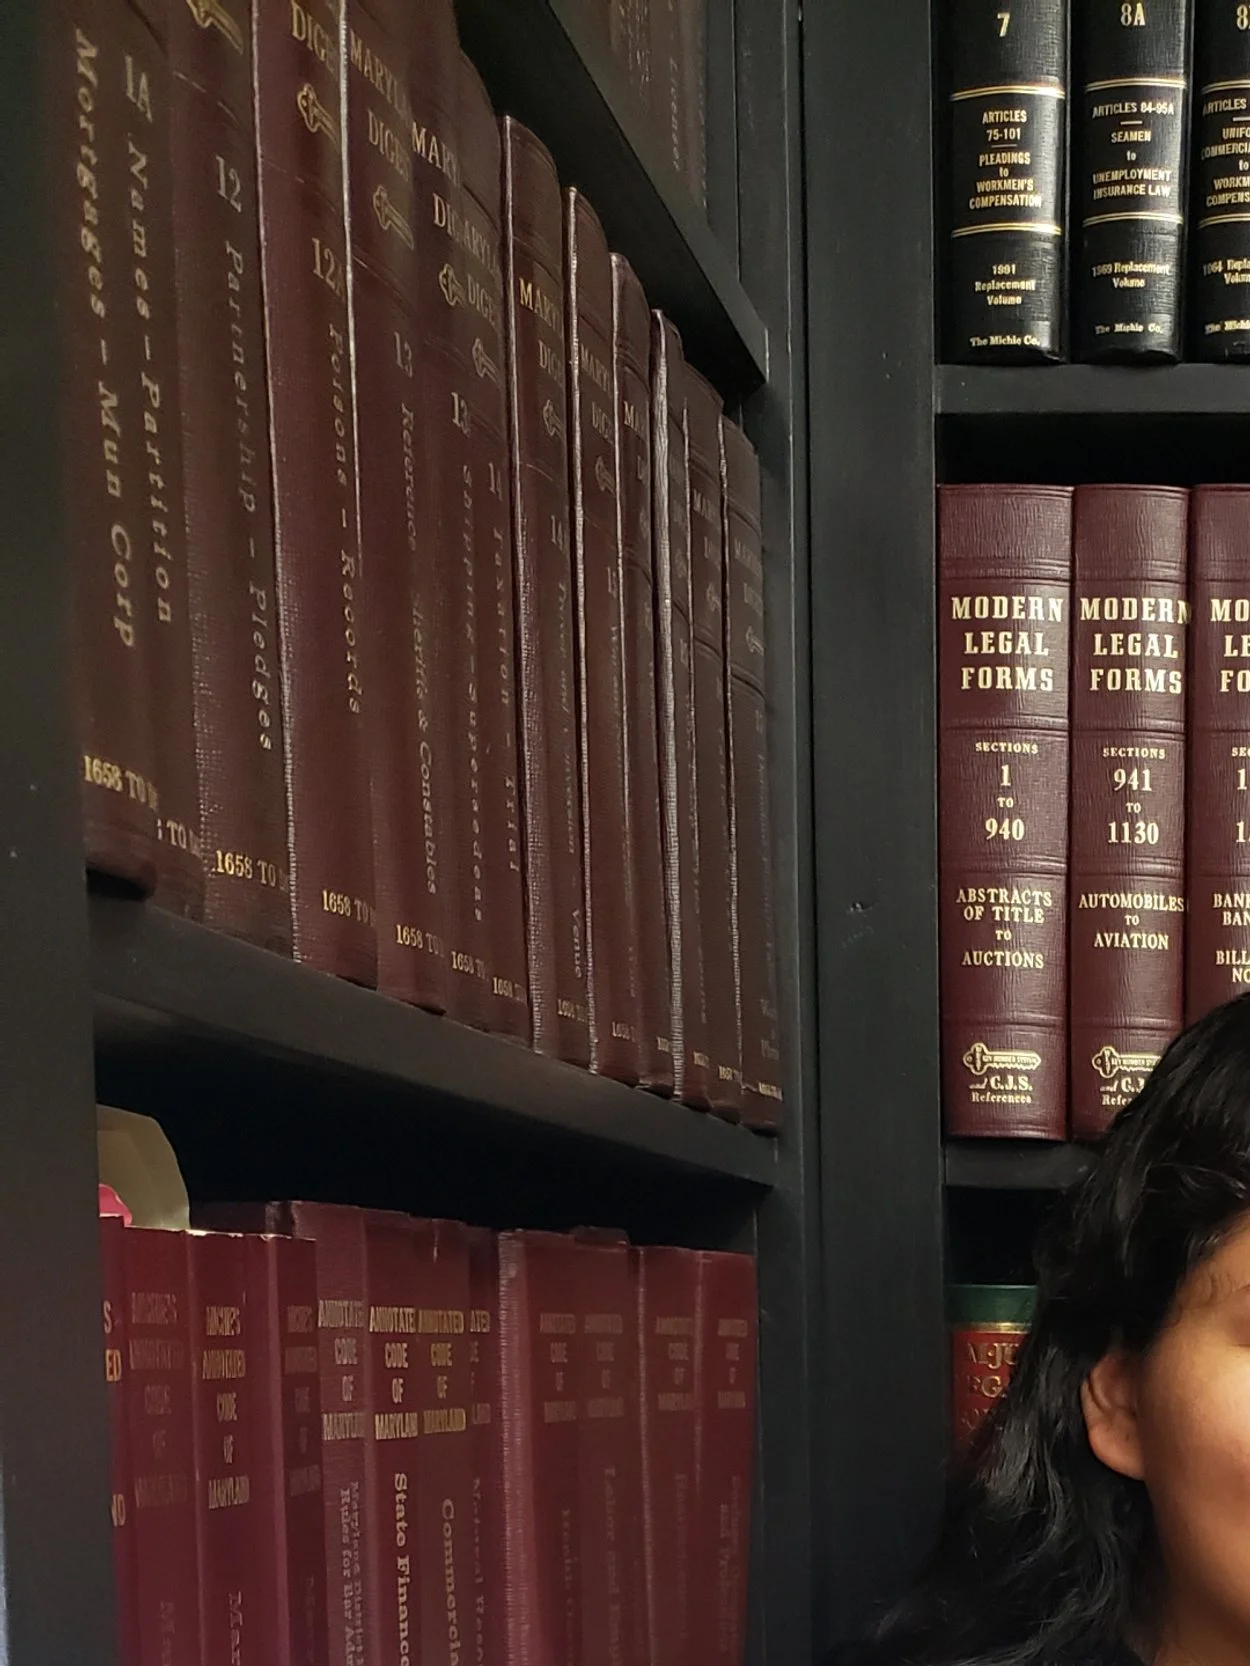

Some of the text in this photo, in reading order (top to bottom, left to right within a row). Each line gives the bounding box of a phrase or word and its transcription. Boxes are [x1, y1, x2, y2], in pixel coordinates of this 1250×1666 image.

[998, 13, 1010, 36] 7
[1121, 3, 1145, 25] 8A
[983, 110, 1026, 123] ARTICLES
[987, 128, 1020, 141] 75-101
[1112, 131, 1151, 142] SEAMEN
[980, 152, 1030, 166] PLEADINGS
[977, 179, 1033, 192] WORKMEN'S
[1094, 184, 1171, 199] INSURANCE LAW
[970, 195, 1041, 209] COMPENSATION
[112, 525, 133, 646] Corp
[952, 596, 1063, 622] MODERN
[1080, 597, 1190, 625] MODERN
[965, 632, 1048, 655] LEGAL
[1094, 634, 1178, 658] LEGAL
[250, 584, 271, 749] Pledges
[961, 667, 1052, 691] FORMS
[1090, 669, 1181, 694] FORMS
[1001, 765, 1010, 786] 1
[1114, 768, 1152, 791] 941
[986, 818, 1024, 840] 940
[1109, 821, 1158, 844] 1130
[217, 850, 275, 886] 1658 TO
[957, 888, 1052, 906] ABSTRACTS
[1079, 894, 1183, 911] AUTOMOBILES
[964, 906, 1044, 923] OF TITLE
[1094, 933, 1168, 949] AVIATION
[963, 951, 1043, 968] AUCTIONS
[395, 1474, 407, 1546] State
